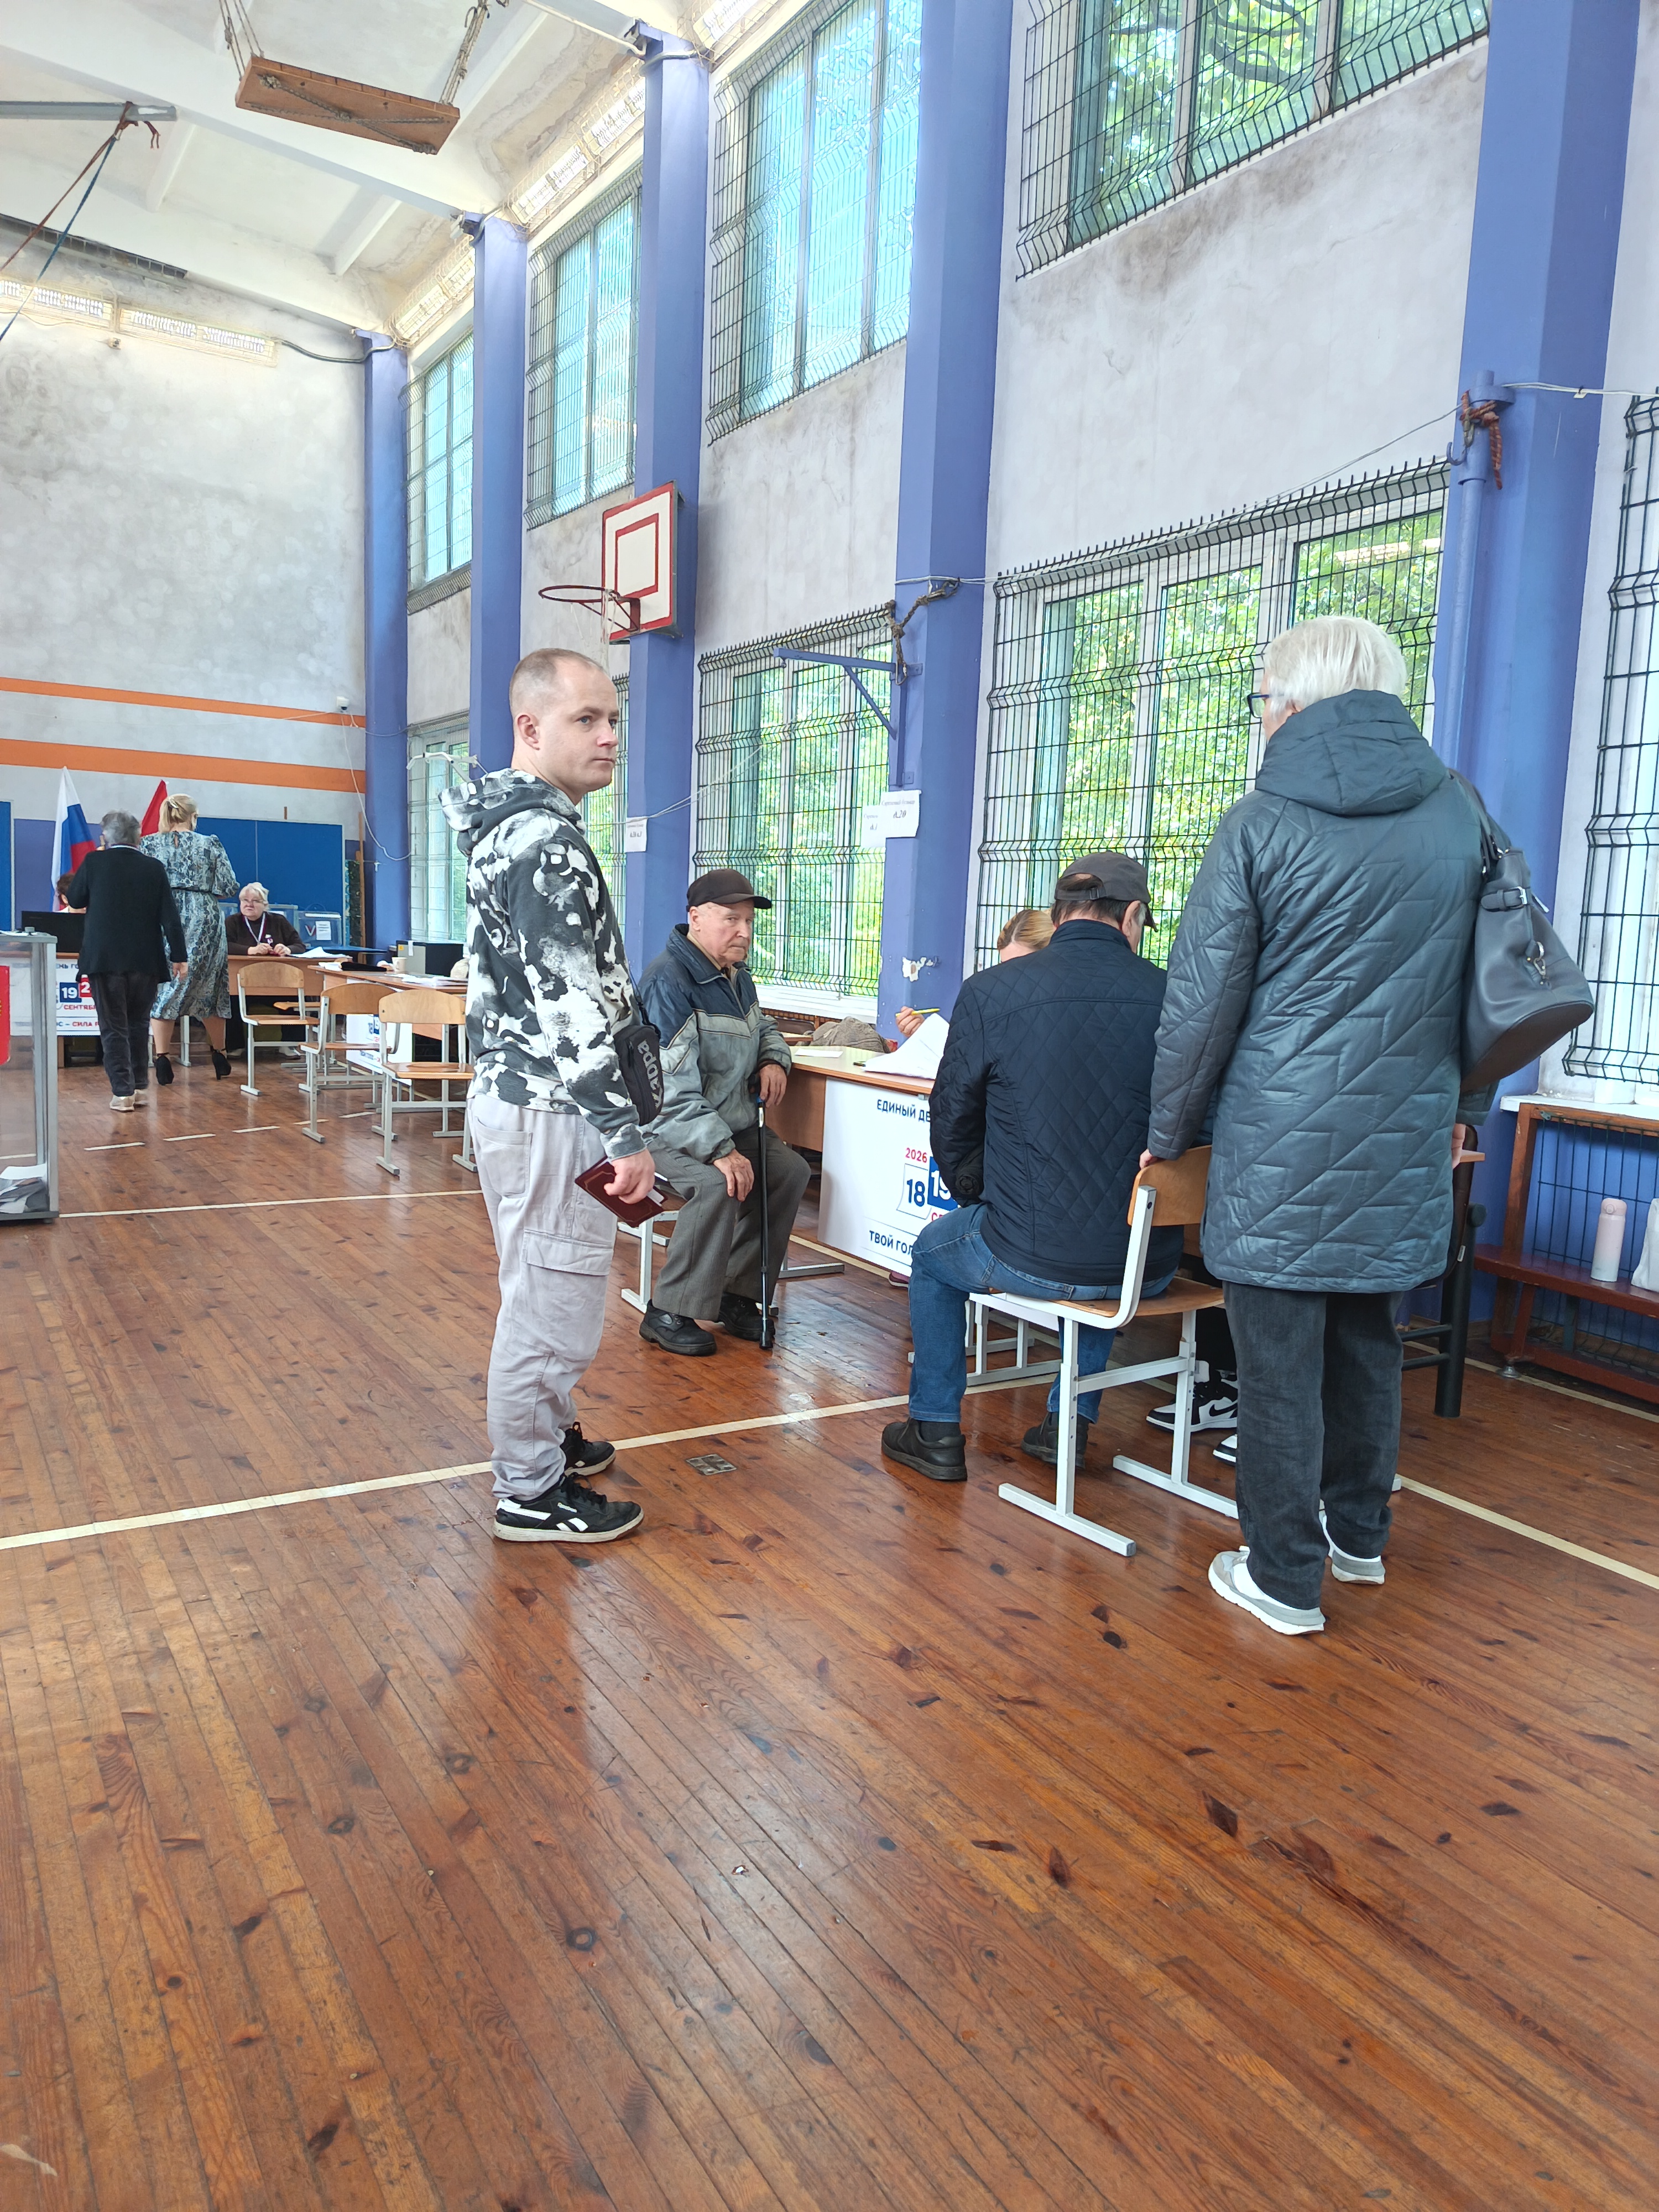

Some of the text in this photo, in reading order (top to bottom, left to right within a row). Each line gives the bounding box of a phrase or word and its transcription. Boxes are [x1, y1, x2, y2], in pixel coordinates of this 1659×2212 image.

[61, 987, 77, 998] 19
[877, 1099, 916, 1119] ЕДИНЫЙ
[905, 1147, 927, 1163] 2026
[907, 1179, 925, 1207] 18
[869, 1230, 893, 1249] ТВОЙ
